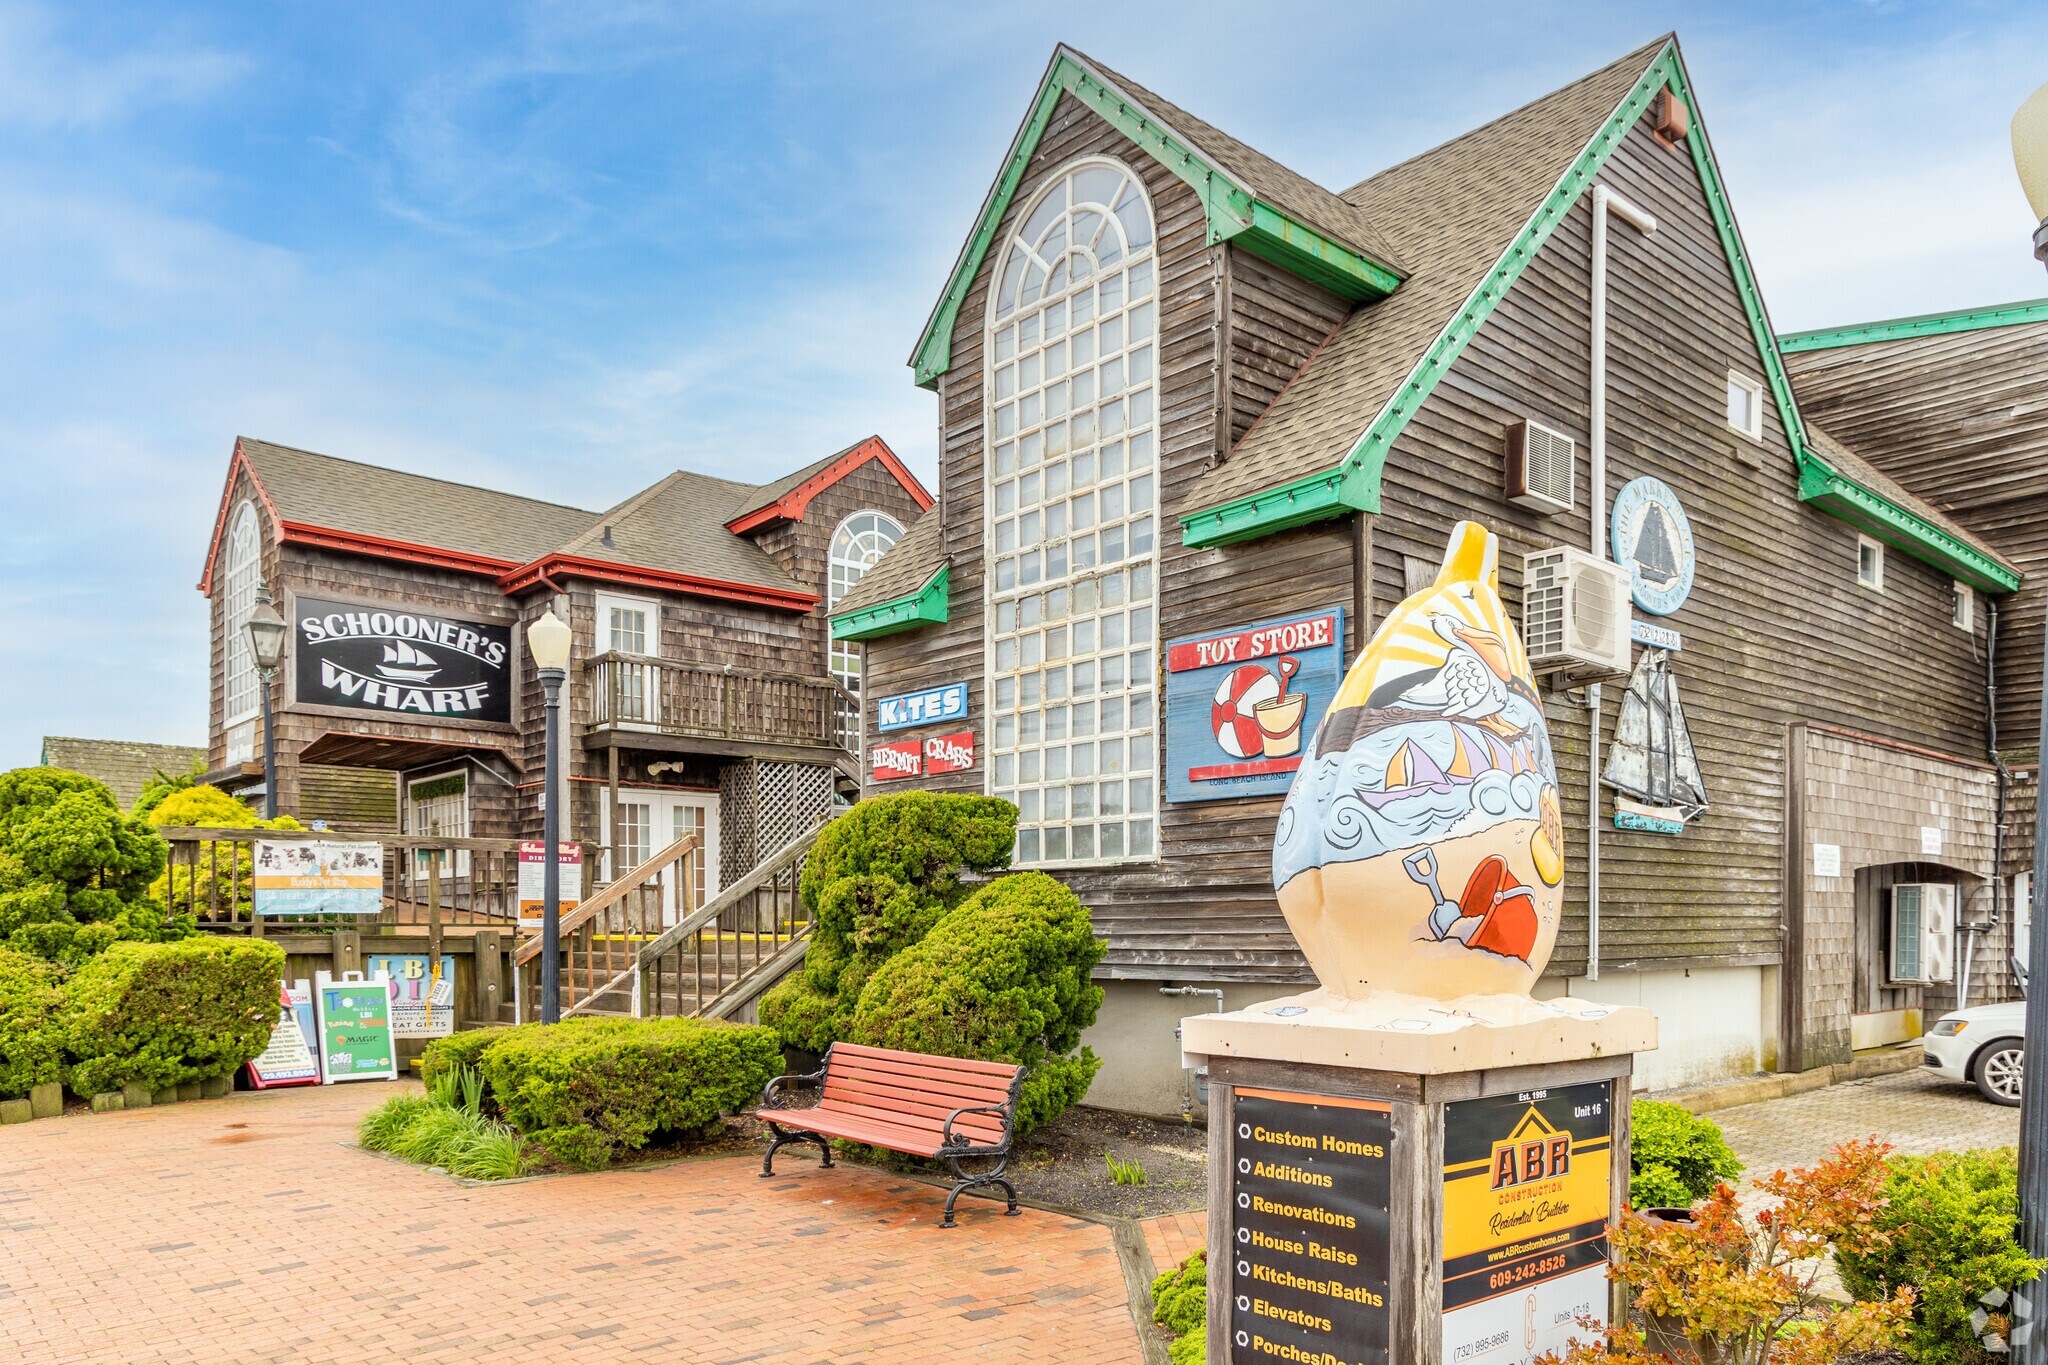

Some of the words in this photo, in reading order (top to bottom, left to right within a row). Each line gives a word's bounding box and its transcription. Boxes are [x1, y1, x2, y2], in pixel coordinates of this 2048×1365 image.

[301, 612, 506, 664] SCHOONER'S
[1197, 637, 1240, 666] TOY
[1250, 619, 1328, 657] STORE
[320, 661, 489, 713] WHARF
[873, 747, 920, 775] HERMIT
[926, 738, 973, 769] CRABS
[1209, 776, 1228, 786] LONG
[1231, 774, 1256, 784] BEACH
[1259, 772, 1287, 782] ISLAND
[290, 877, 318, 887] Buddy's
[319, 877, 330, 886] Pet
[332, 877, 349, 887] Stop
[345, 1035, 379, 1043] MAGIC
[1518, 1092, 1531, 1101] Est.
[1532, 1090, 1547, 1100] 1995
[1574, 1105, 1591, 1118] Unit
[1591, 1103, 1602, 1116] 16
[1254, 1126, 1317, 1149] Custom
[1322, 1134, 1384, 1158] Homes
[1253, 1161, 1333, 1188] Additions
[1490, 1135, 1571, 1192] ABR
[1498, 1181, 1563, 1205] CONSTRUCTION
[1253, 1195, 1356, 1229] Renovations
[1489, 1207, 1535, 1237] Residential
[1535, 1200, 1570, 1222] Builders
[1252, 1230, 1304, 1254] House
[1308, 1241, 1358, 1266] Raise
[1487, 1232, 1570, 1262] www.ABRcustomhome.com
[1253, 1263, 1383, 1308] Kitchens/Baths
[1489, 1254, 1566, 1289] 609-242-8526
[1253, 1298, 1332, 1332] Elevators
[1554, 1308, 1571, 1324] Units
[1572, 1302, 1590, 1317] 17-18
[1253, 1334, 1364, 1365] Porches/D
[1453, 1343, 1474, 1364] (732)
[1475, 1330, 1510, 1354] 995-9686
